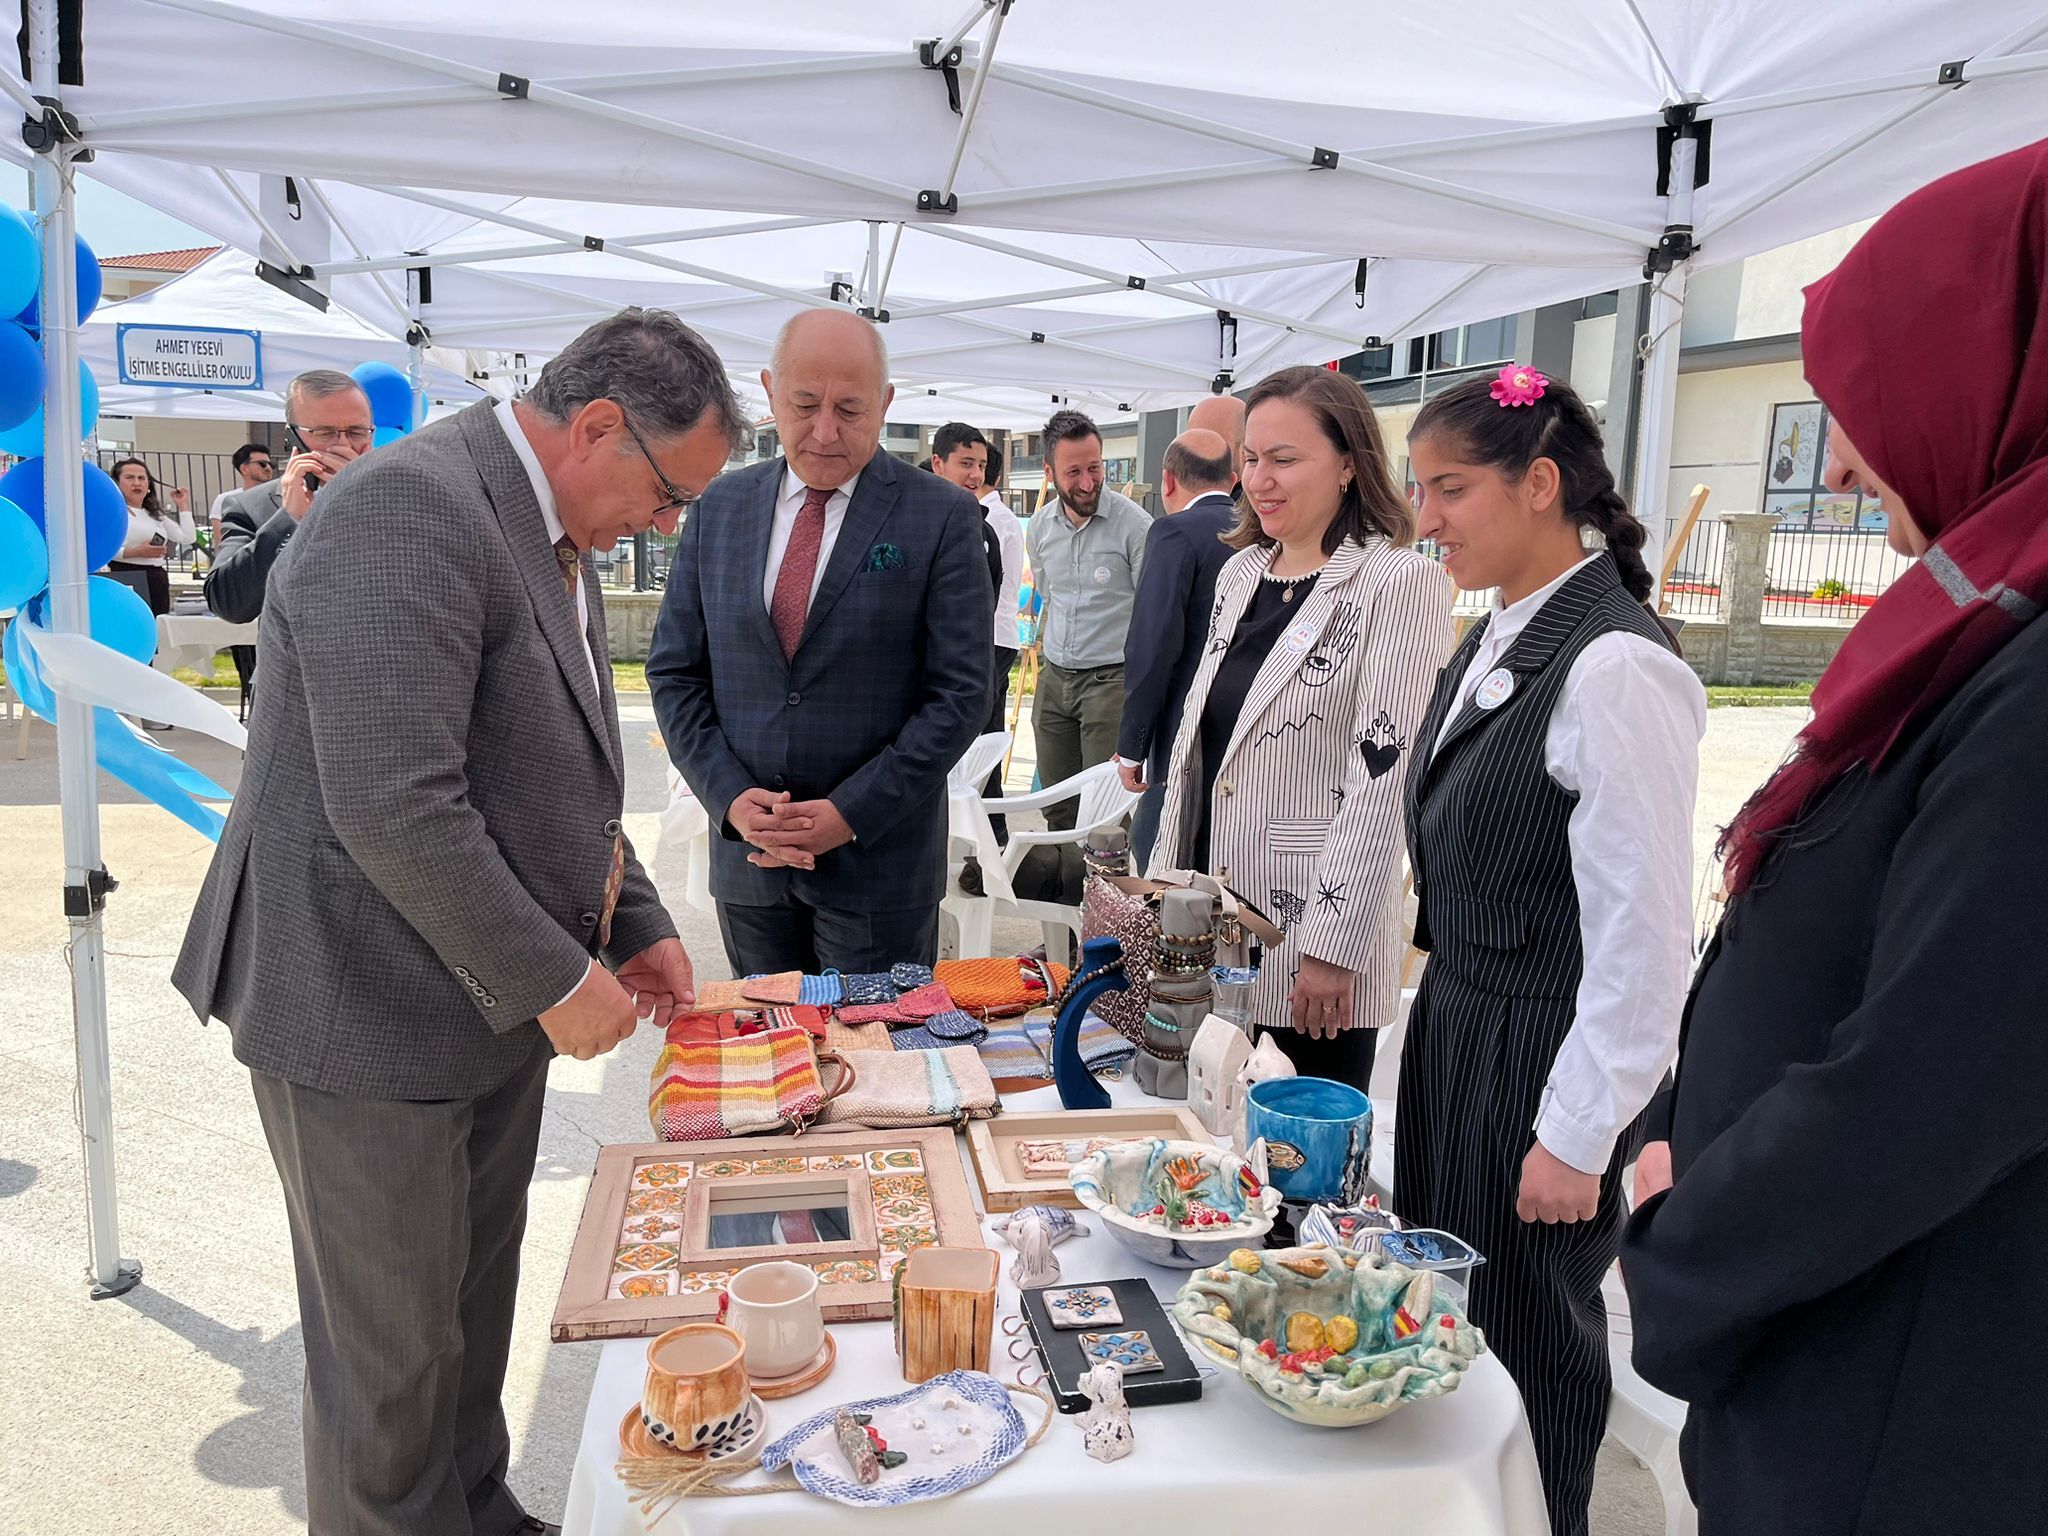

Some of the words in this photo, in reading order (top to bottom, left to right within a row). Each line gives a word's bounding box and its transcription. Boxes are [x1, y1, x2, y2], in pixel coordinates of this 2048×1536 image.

[155, 338, 189, 354] AHMET
[190, 339, 223, 356] YESEVİ
[129, 356, 160, 378] İŞİTME
[162, 360, 218, 378] ENGELLİLER
[219, 365, 251, 380] OKULU
